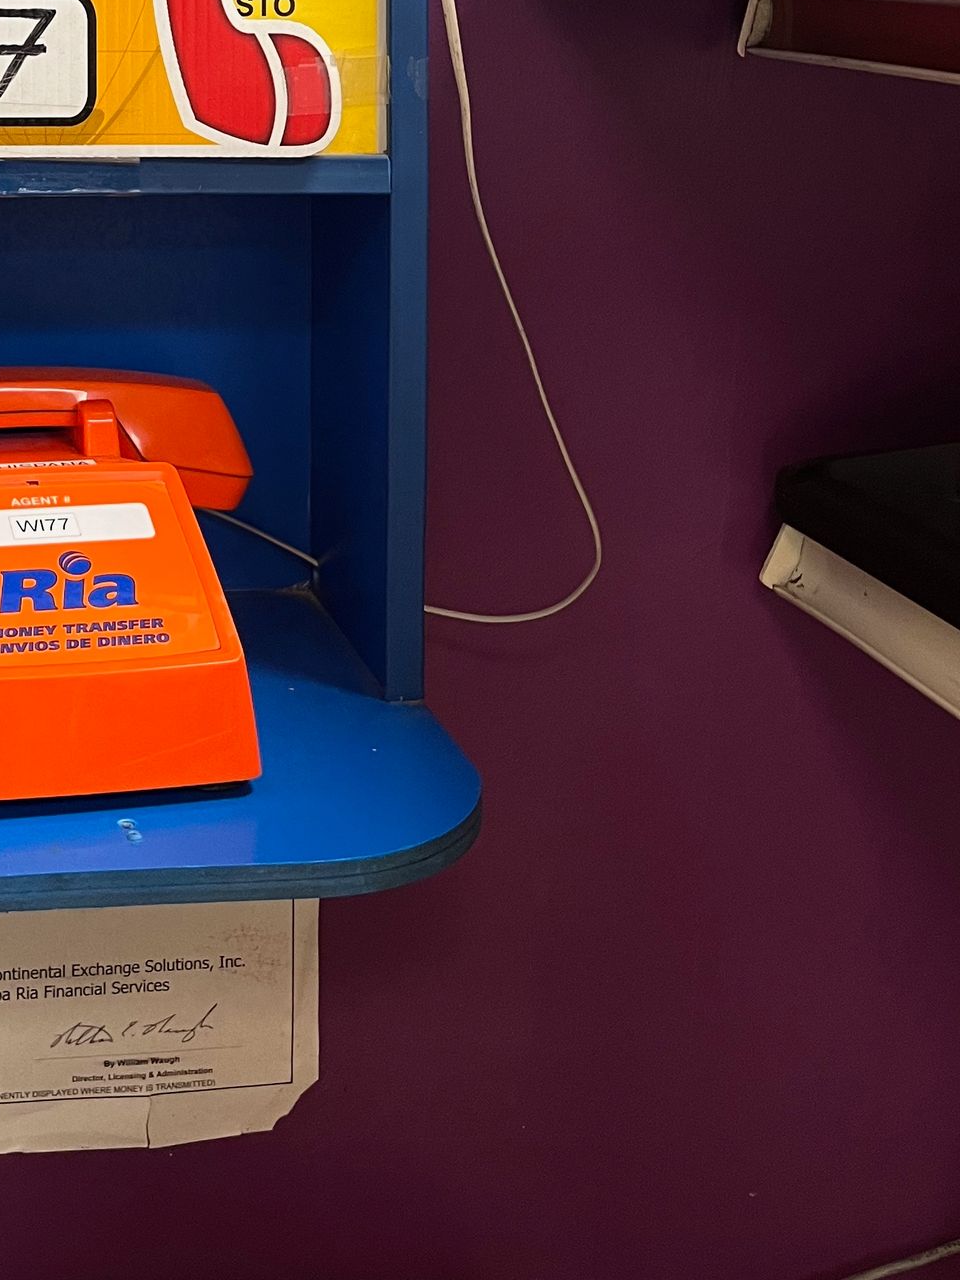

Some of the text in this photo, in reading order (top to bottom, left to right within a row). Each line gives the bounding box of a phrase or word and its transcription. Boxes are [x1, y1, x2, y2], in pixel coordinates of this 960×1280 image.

[11, 495, 60, 508] AGENT
[15, 518, 69, 533] WI77
[0, 551, 139, 614] Ria
[62, 618, 164, 635] TRANSFER
[66, 638, 92, 650] DE
[97, 632, 170, 648] DINERO
[71, 962, 140, 978] Exchange
[144, 956, 214, 972] Solutions,
[219, 954, 246, 969] Inc.
[17, 986, 38, 1000] Ria
[44, 982, 106, 998] Financial
[112, 979, 169, 994] Services
[71, 1073, 106, 1083] Director,
[155, 1066, 214, 1078] Administration
